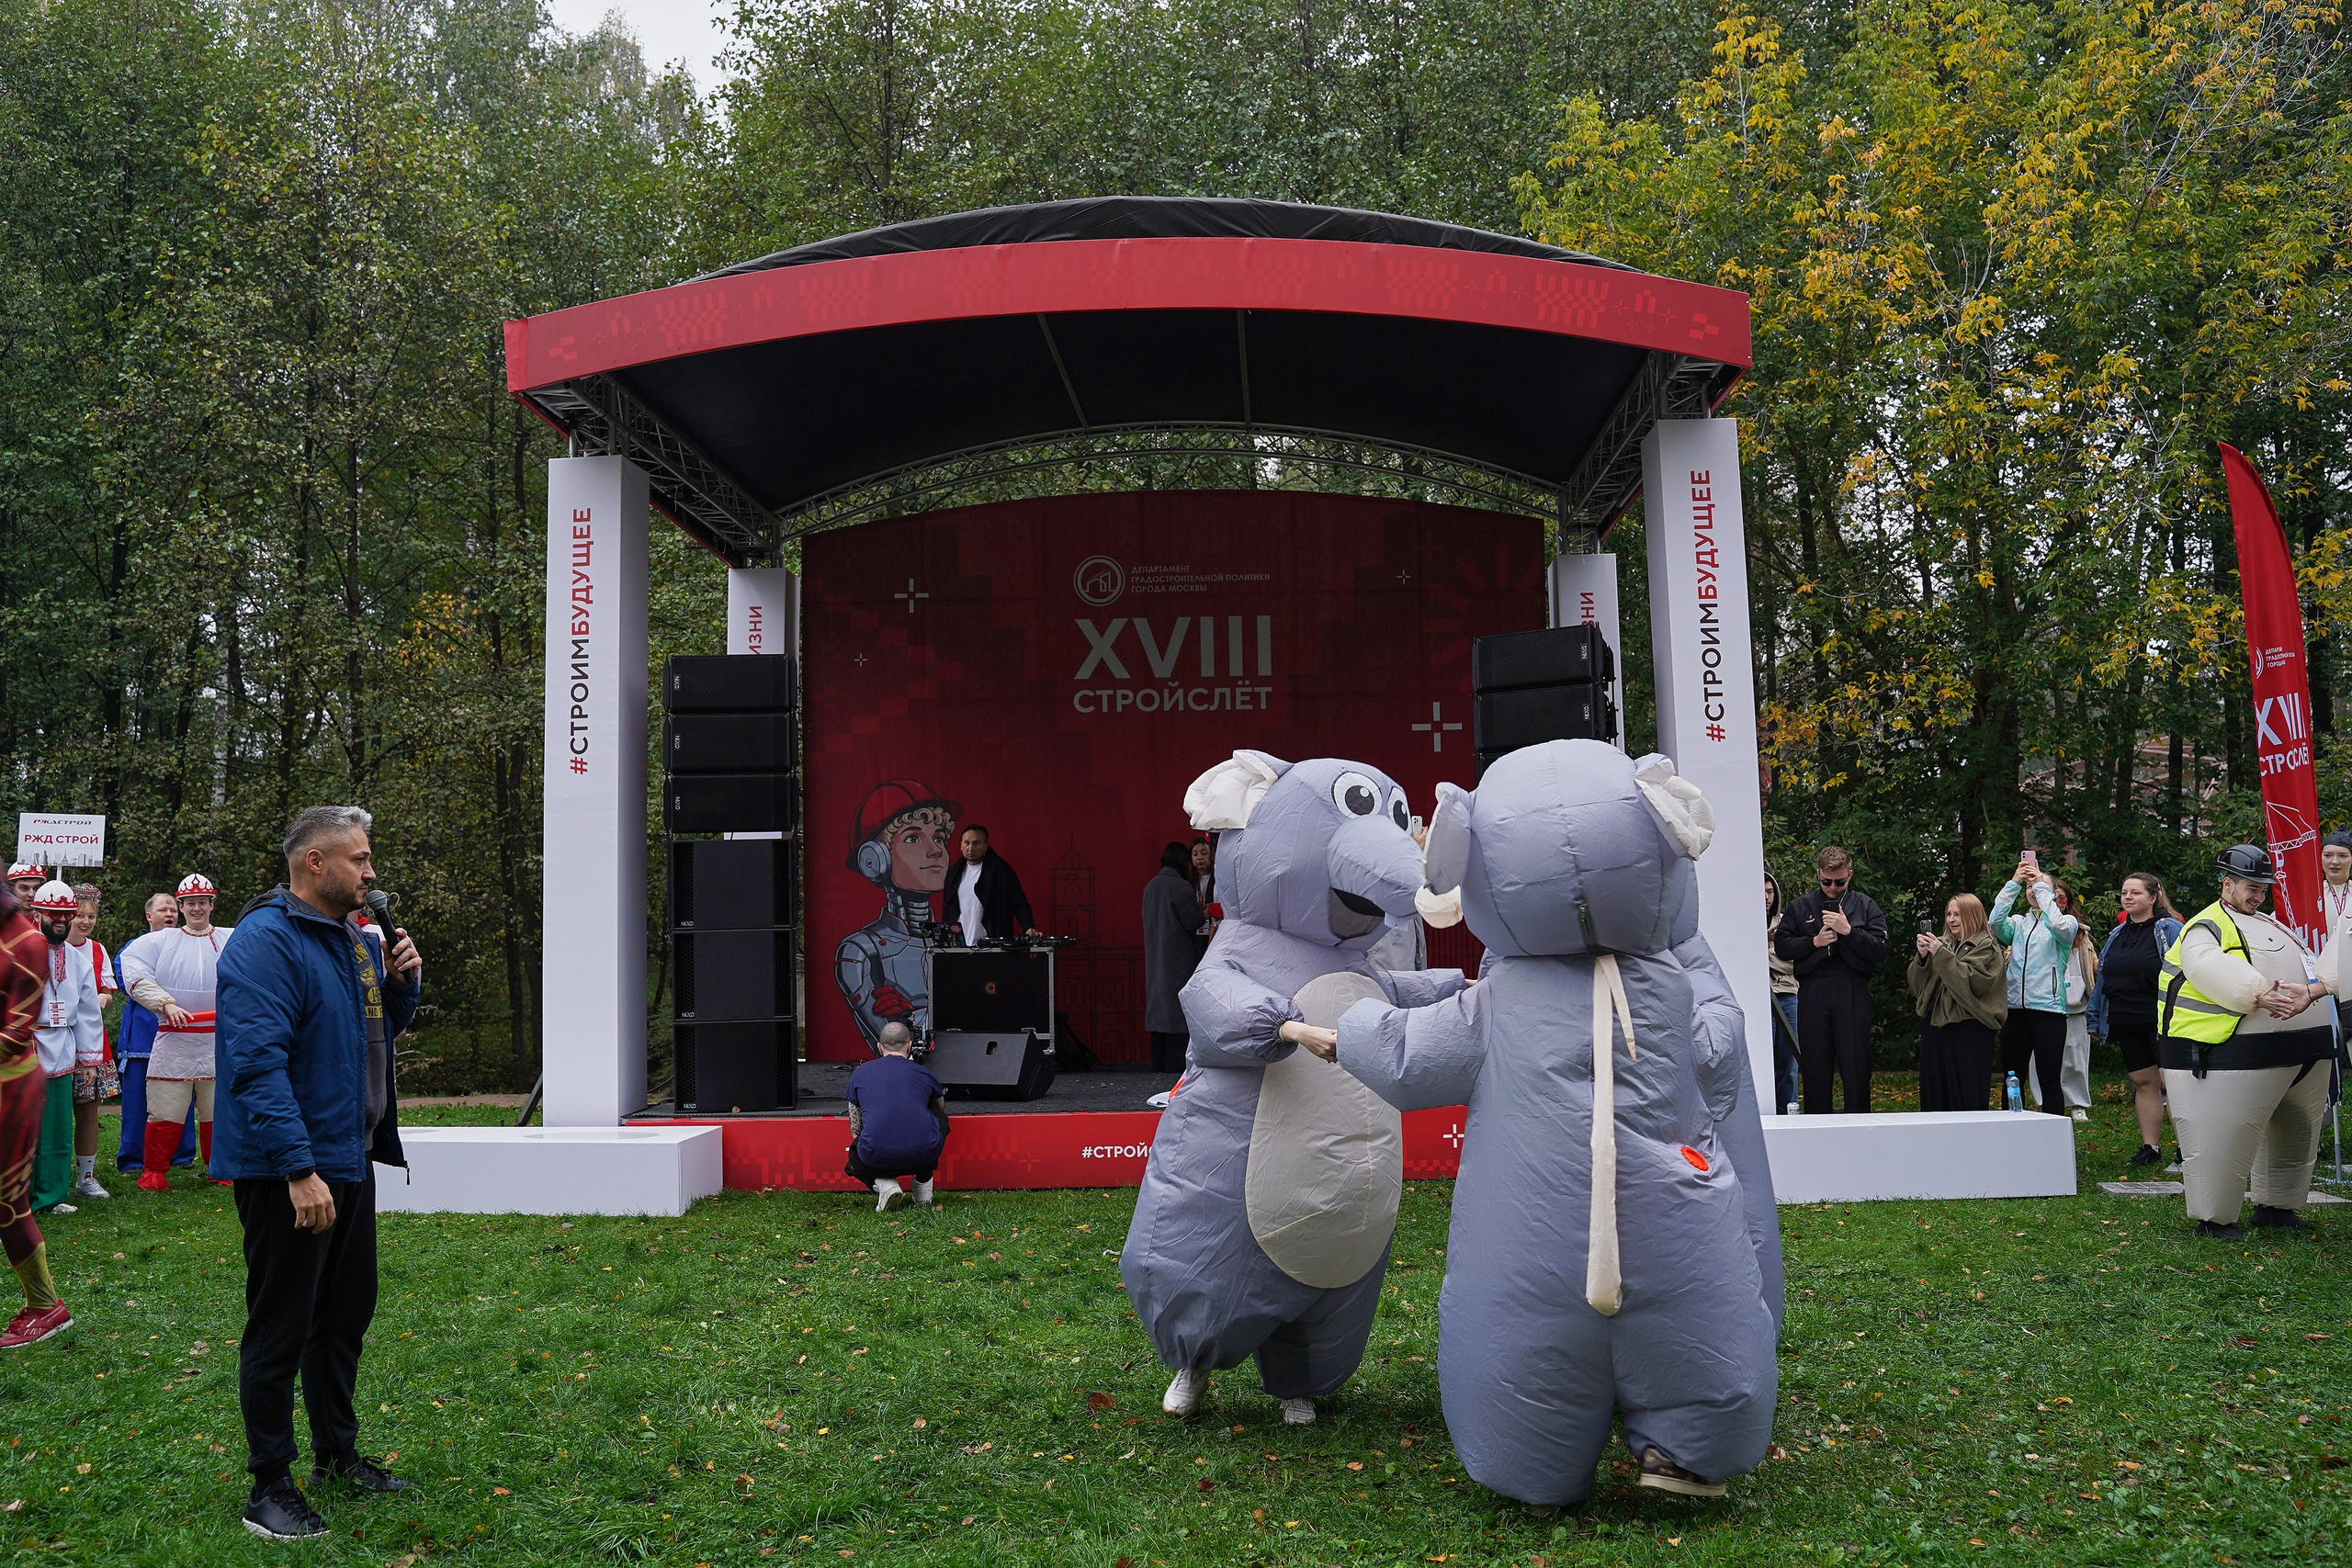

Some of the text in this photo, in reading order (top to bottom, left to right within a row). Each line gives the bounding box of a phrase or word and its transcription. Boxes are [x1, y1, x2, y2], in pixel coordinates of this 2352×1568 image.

[1131, 565, 1191, 574] ДЕПАРТАМЕНТ
[1131, 573, 1271, 583] ГРАДОСТРОИТЕЛЬНОЙ ПОЛИТИКИ
[1169, 584, 1207, 592] МОСКВЫ
[1690, 469, 1725, 743] #СТРОИМБУДУЩЕЕ
[570, 507, 594, 775] #СТРОИМБУДУЩЕЕ
[1073, 615, 1272, 680] XVIII
[1073, 681, 1272, 713] СТРОЙСЛЁТ
[25, 834, 98, 844] РЖД СТРОЙ
